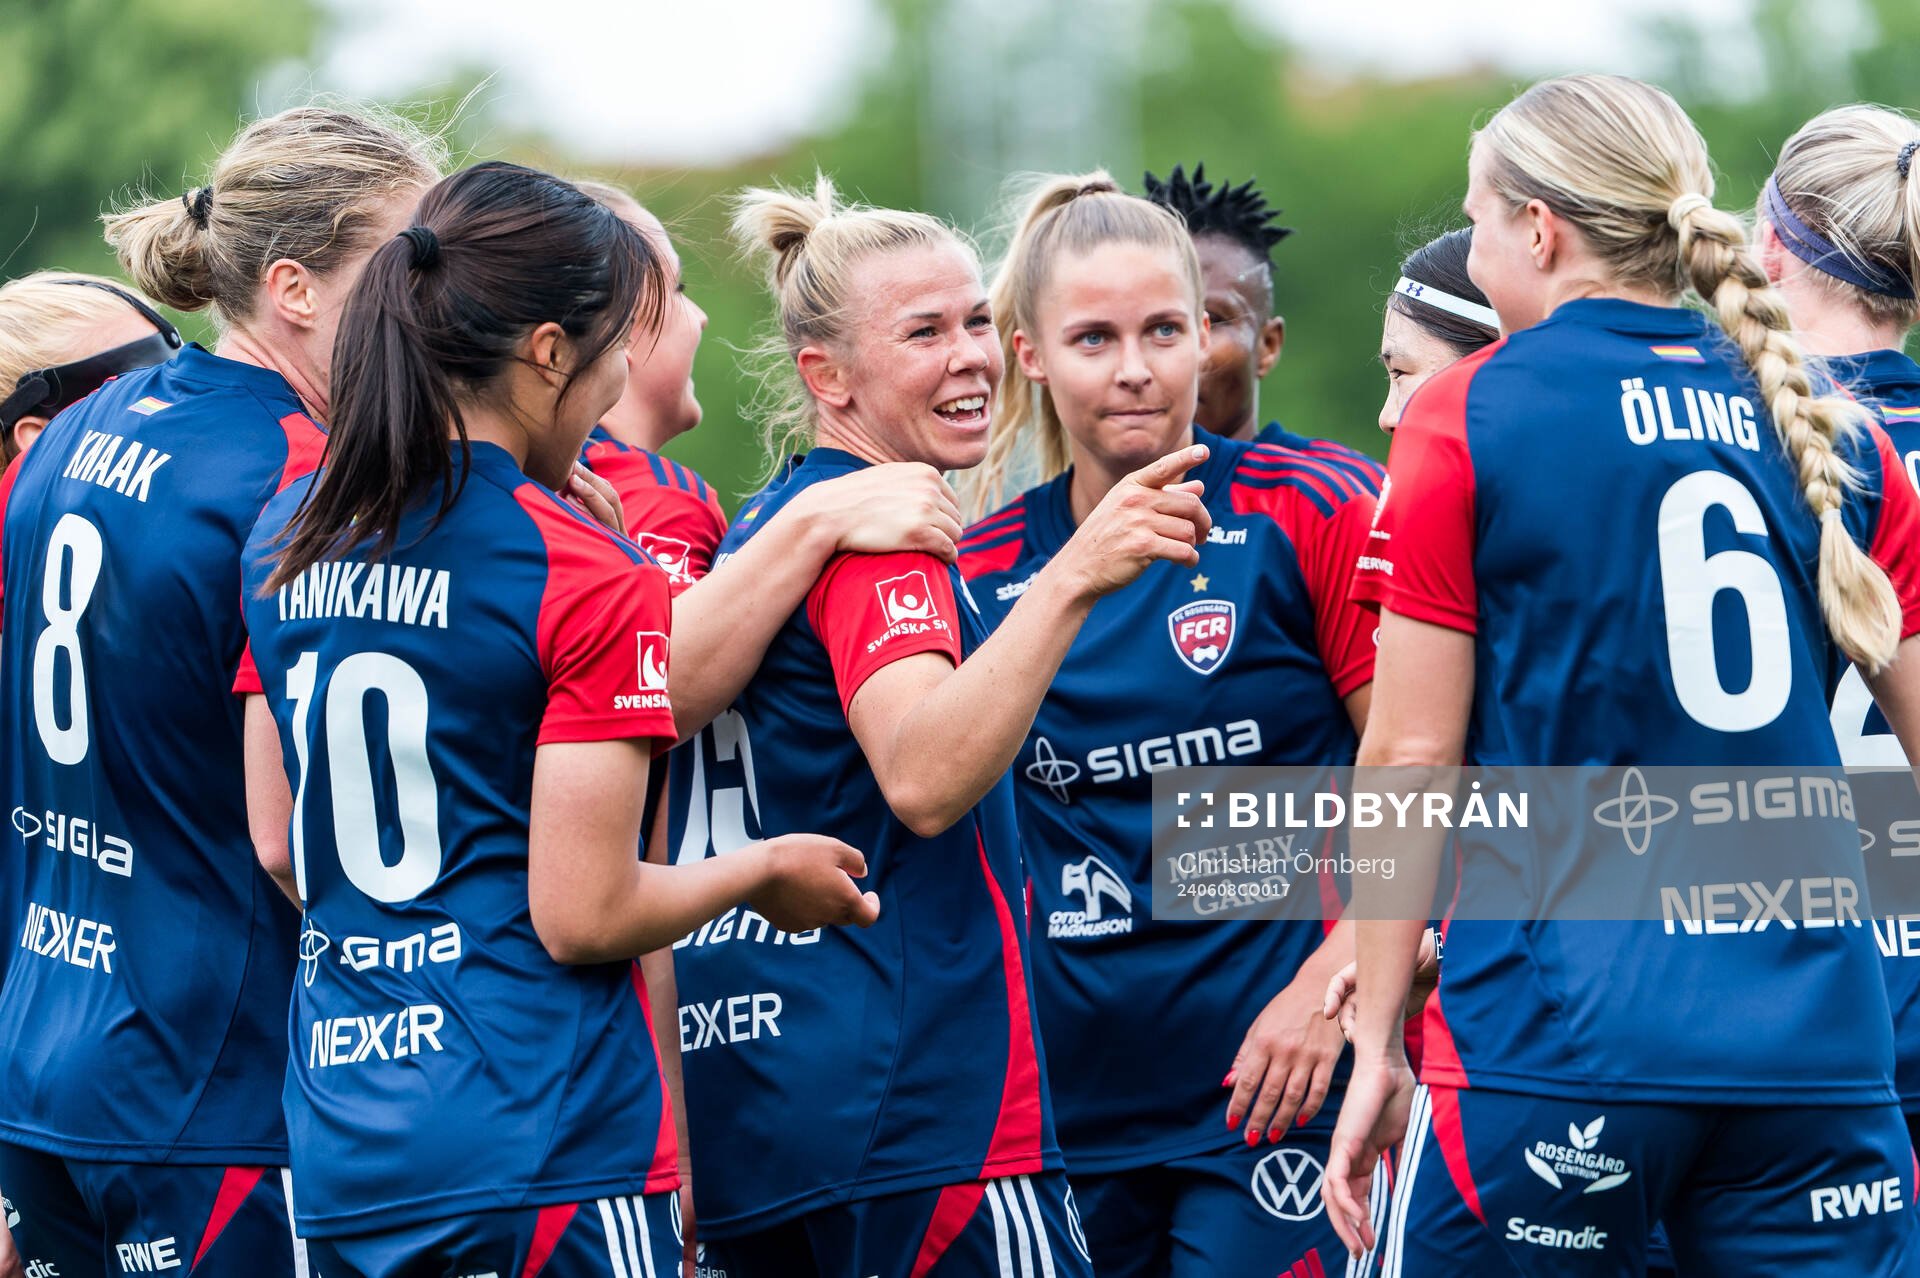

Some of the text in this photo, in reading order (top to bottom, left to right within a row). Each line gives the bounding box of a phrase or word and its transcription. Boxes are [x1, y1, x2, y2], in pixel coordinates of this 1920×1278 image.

[1620, 377, 1761, 452] ÖLING
[62, 430, 172, 503] KNAAK
[1658, 470, 1792, 732] 6
[33, 513, 102, 765] 8
[866, 622, 932, 653] SVENSKA
[1180, 616, 1227, 643] FCR
[286, 651, 442, 903] 10
[1049, 911, 1087, 925] OTTO
[677, 992, 783, 1053] EXER
[1810, 1176, 1904, 1222] RWE
[115, 1236, 182, 1273] RWE
[1505, 1217, 1608, 1249] Scandic
